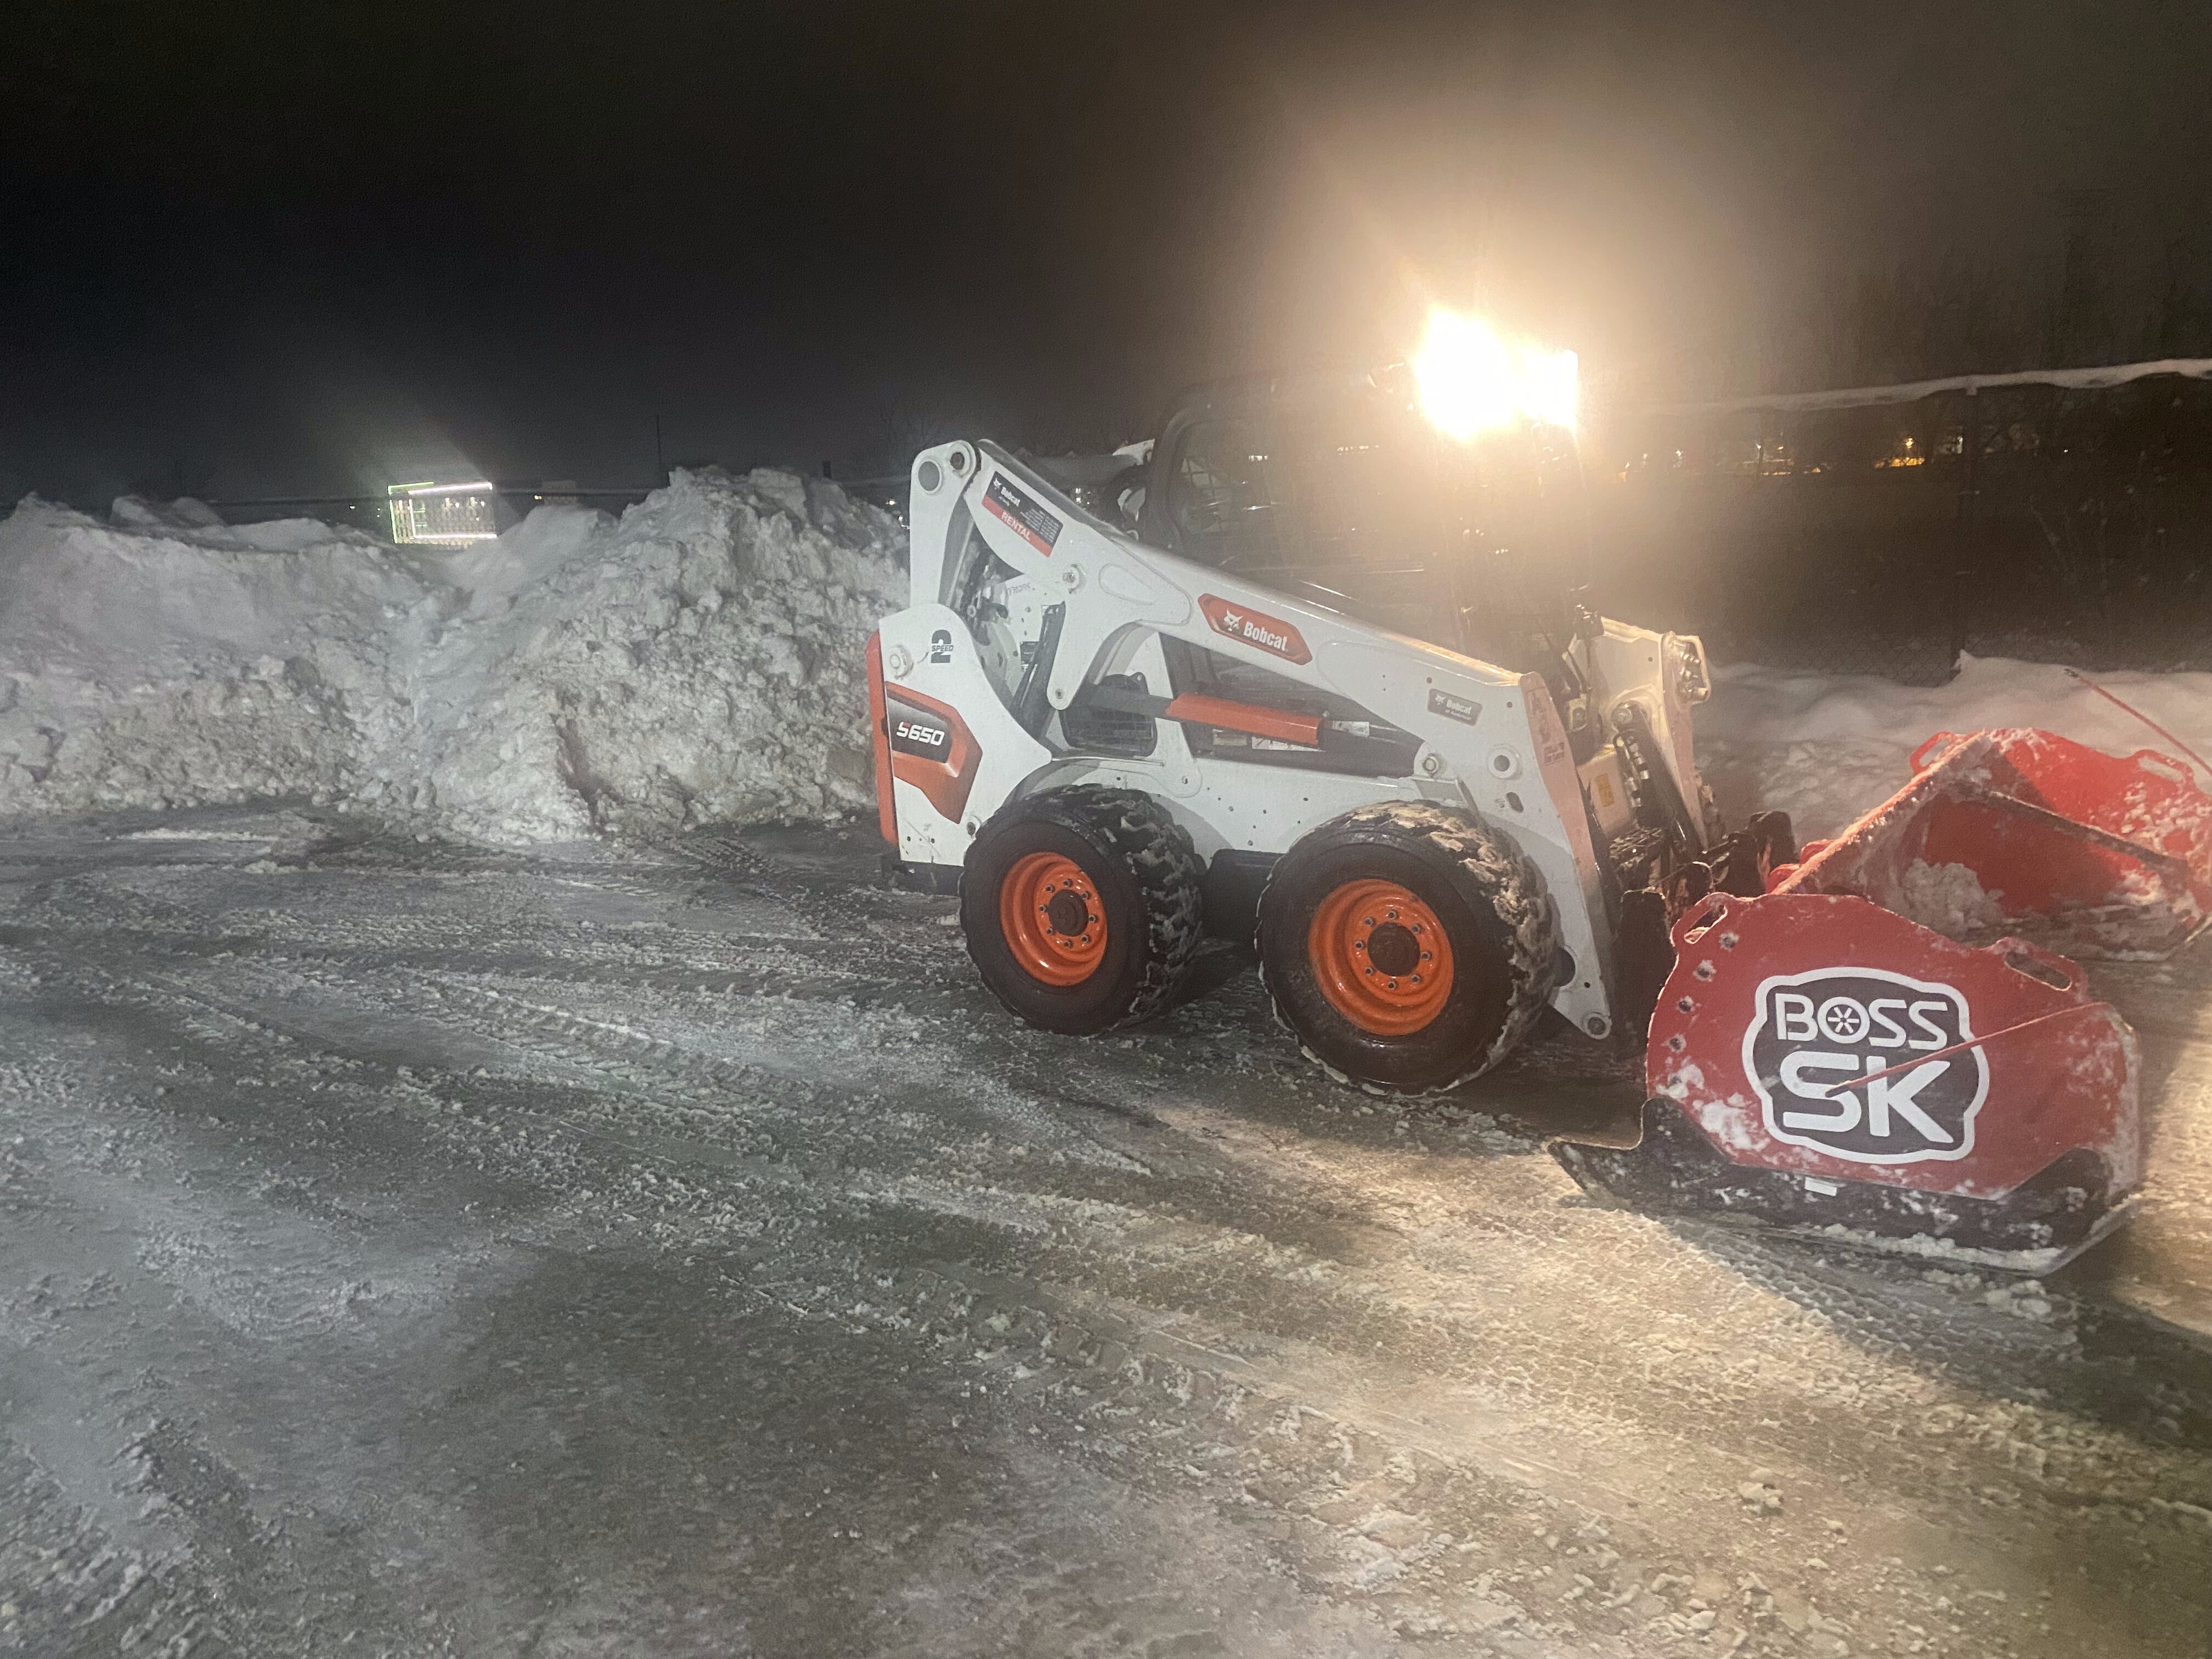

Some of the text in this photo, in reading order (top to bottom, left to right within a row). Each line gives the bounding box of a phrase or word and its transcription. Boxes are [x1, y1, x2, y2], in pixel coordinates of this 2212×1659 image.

[1001, 511, 1030, 540] RENTAL
[931, 629, 951, 663] 2
[1243, 621, 1288, 651] Bobcat
[1446, 699, 1471, 714] Bobcat
[896, 721, 945, 746] S650
[1775, 992, 1948, 1051] BOSS
[1780, 1051, 1954, 1143] SK
